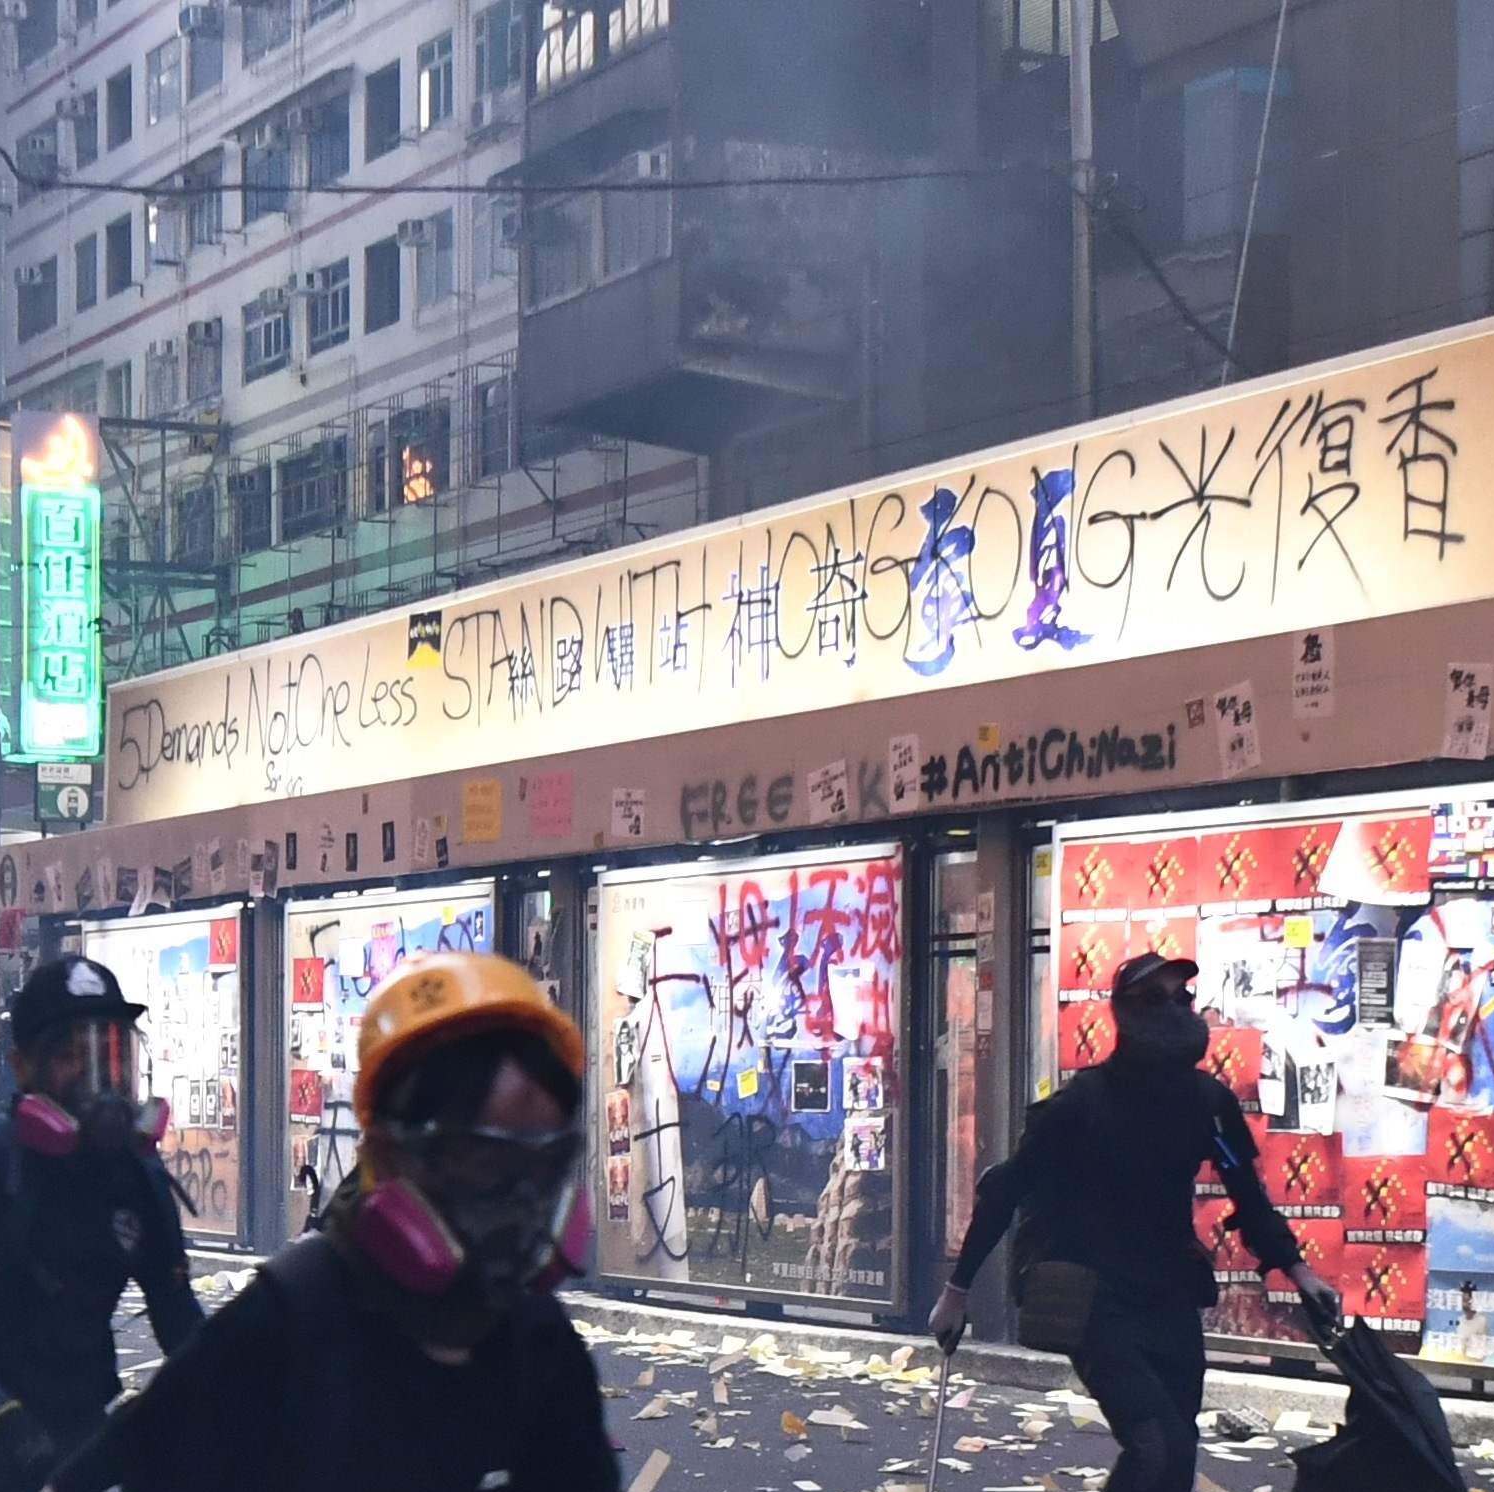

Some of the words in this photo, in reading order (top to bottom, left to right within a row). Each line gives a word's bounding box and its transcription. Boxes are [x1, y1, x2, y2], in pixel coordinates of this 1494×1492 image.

[358, 642, 418, 729] Less
[442, 594, 585, 728] STAND
[594, 545, 713, 694] WITH
[920, 722, 1178, 803] #AntiChiNazi
